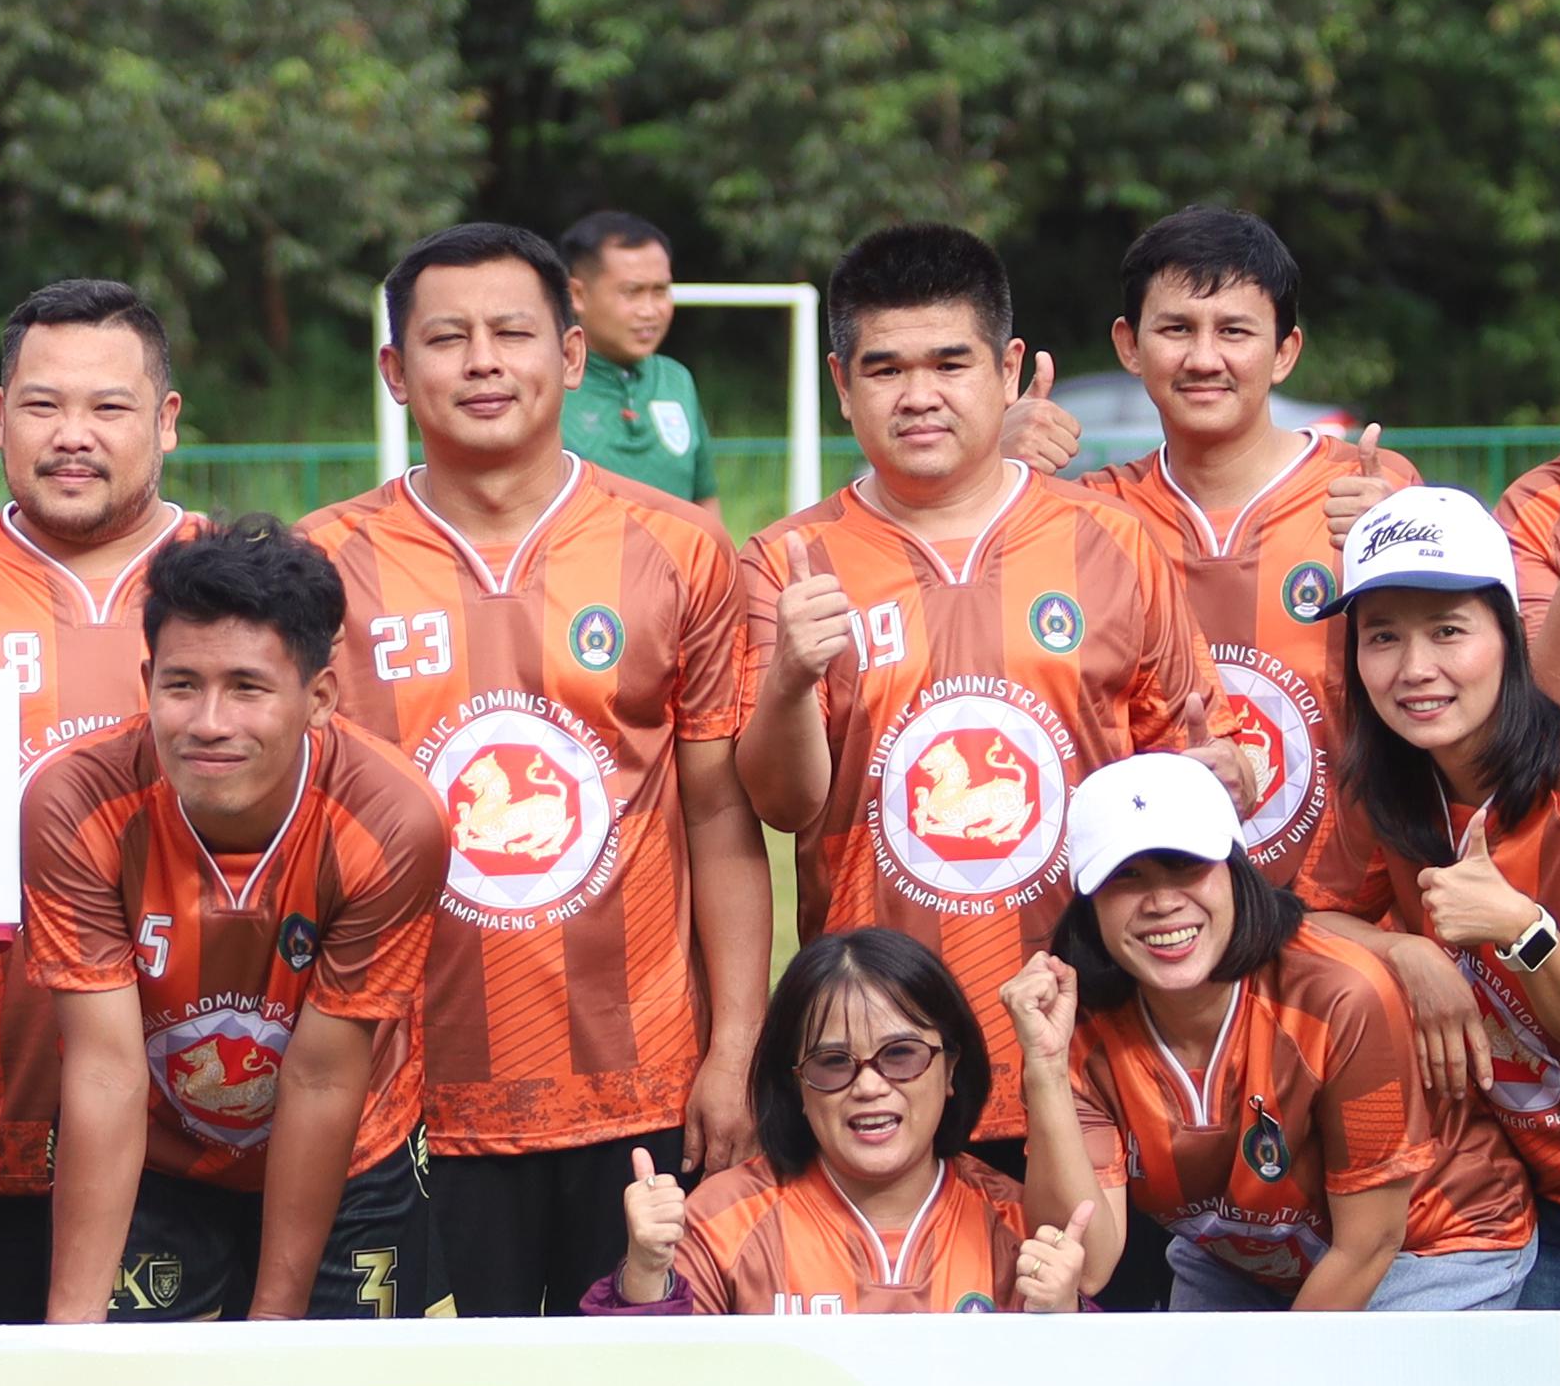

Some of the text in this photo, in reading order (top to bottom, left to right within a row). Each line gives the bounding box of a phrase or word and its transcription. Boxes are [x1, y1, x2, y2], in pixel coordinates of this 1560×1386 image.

[1358, 518, 1444, 564] Athletic
[369, 609, 453, 682] 23
[457, 688, 619, 777] ADMINISTRATION
[918, 673, 1077, 761] ADMINISTRATION
[1286, 747, 1328, 844] UNIVERSITY
[545, 891, 588, 926] PHET
[894, 874, 996, 916] KAMPHAENG
[1005, 882, 1046, 911] PHET
[135, 912, 174, 979] 5
